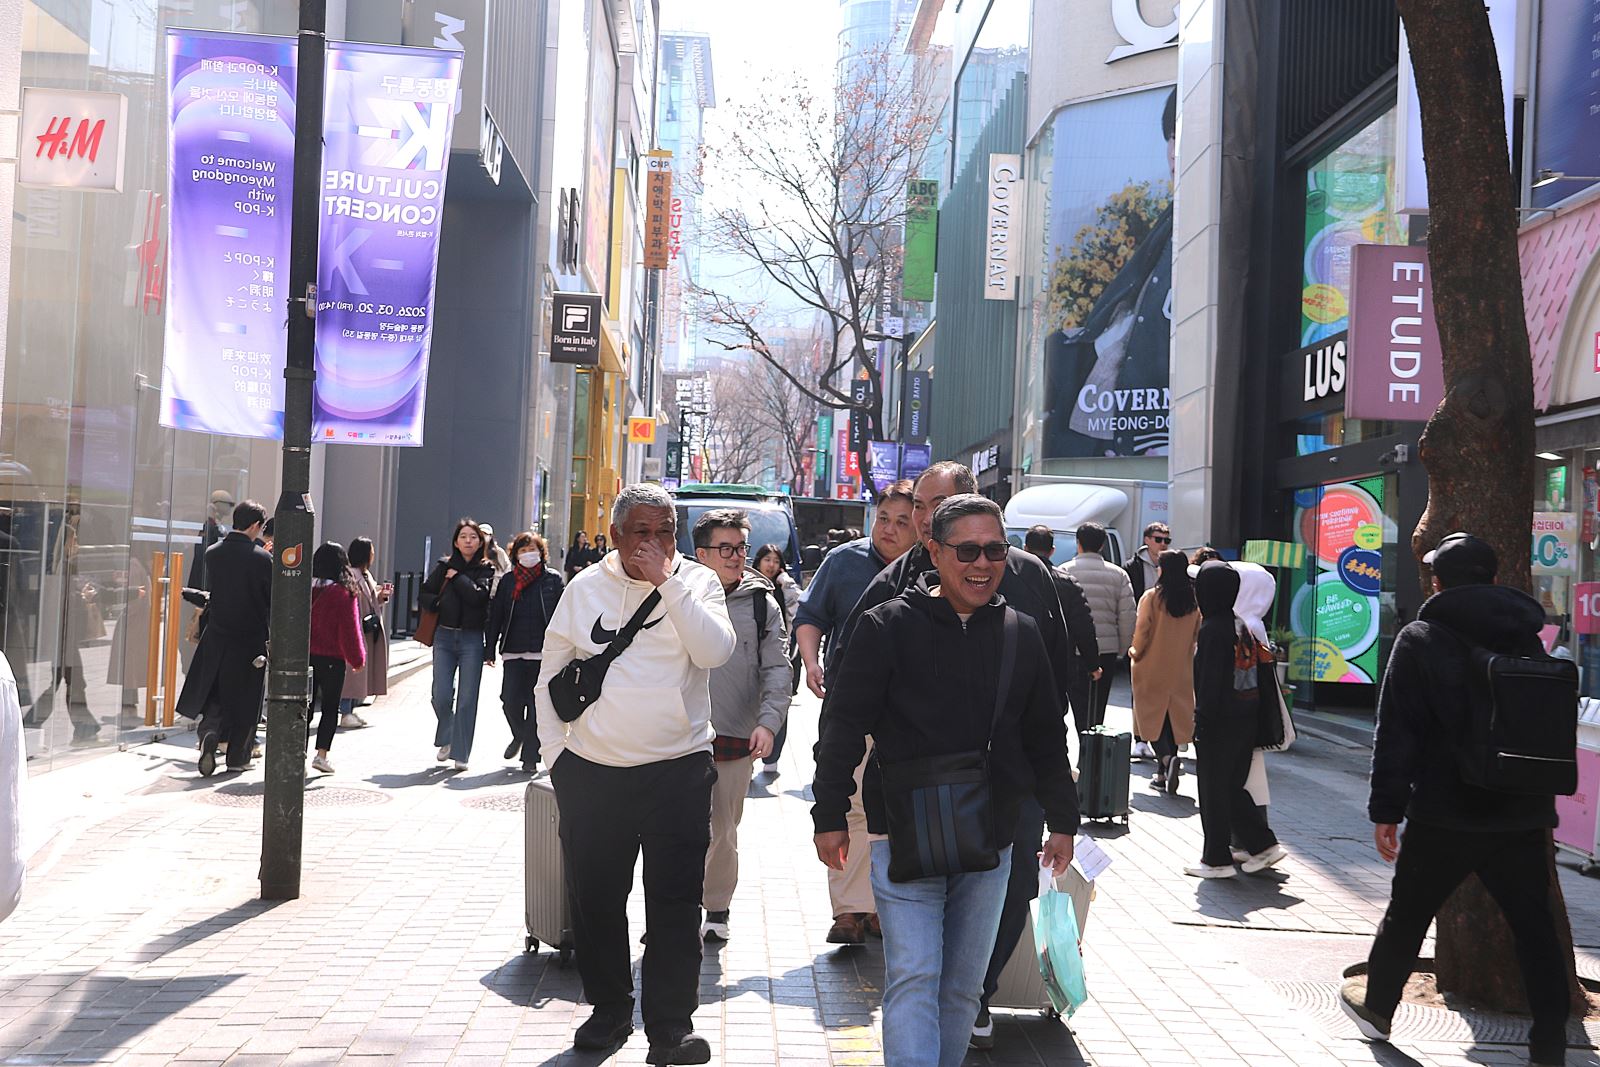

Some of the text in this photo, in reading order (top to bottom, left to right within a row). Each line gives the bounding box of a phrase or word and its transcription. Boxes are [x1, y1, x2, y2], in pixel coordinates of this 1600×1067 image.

[36, 117, 105, 163] H&M
[909, 182, 936, 196] ABC
[989, 163, 1017, 291] COVERNAT
[553, 335, 598, 347] Born in Italy
[1388, 261, 1424, 404] ETUDE
[911, 410, 919, 436] YOUNG
